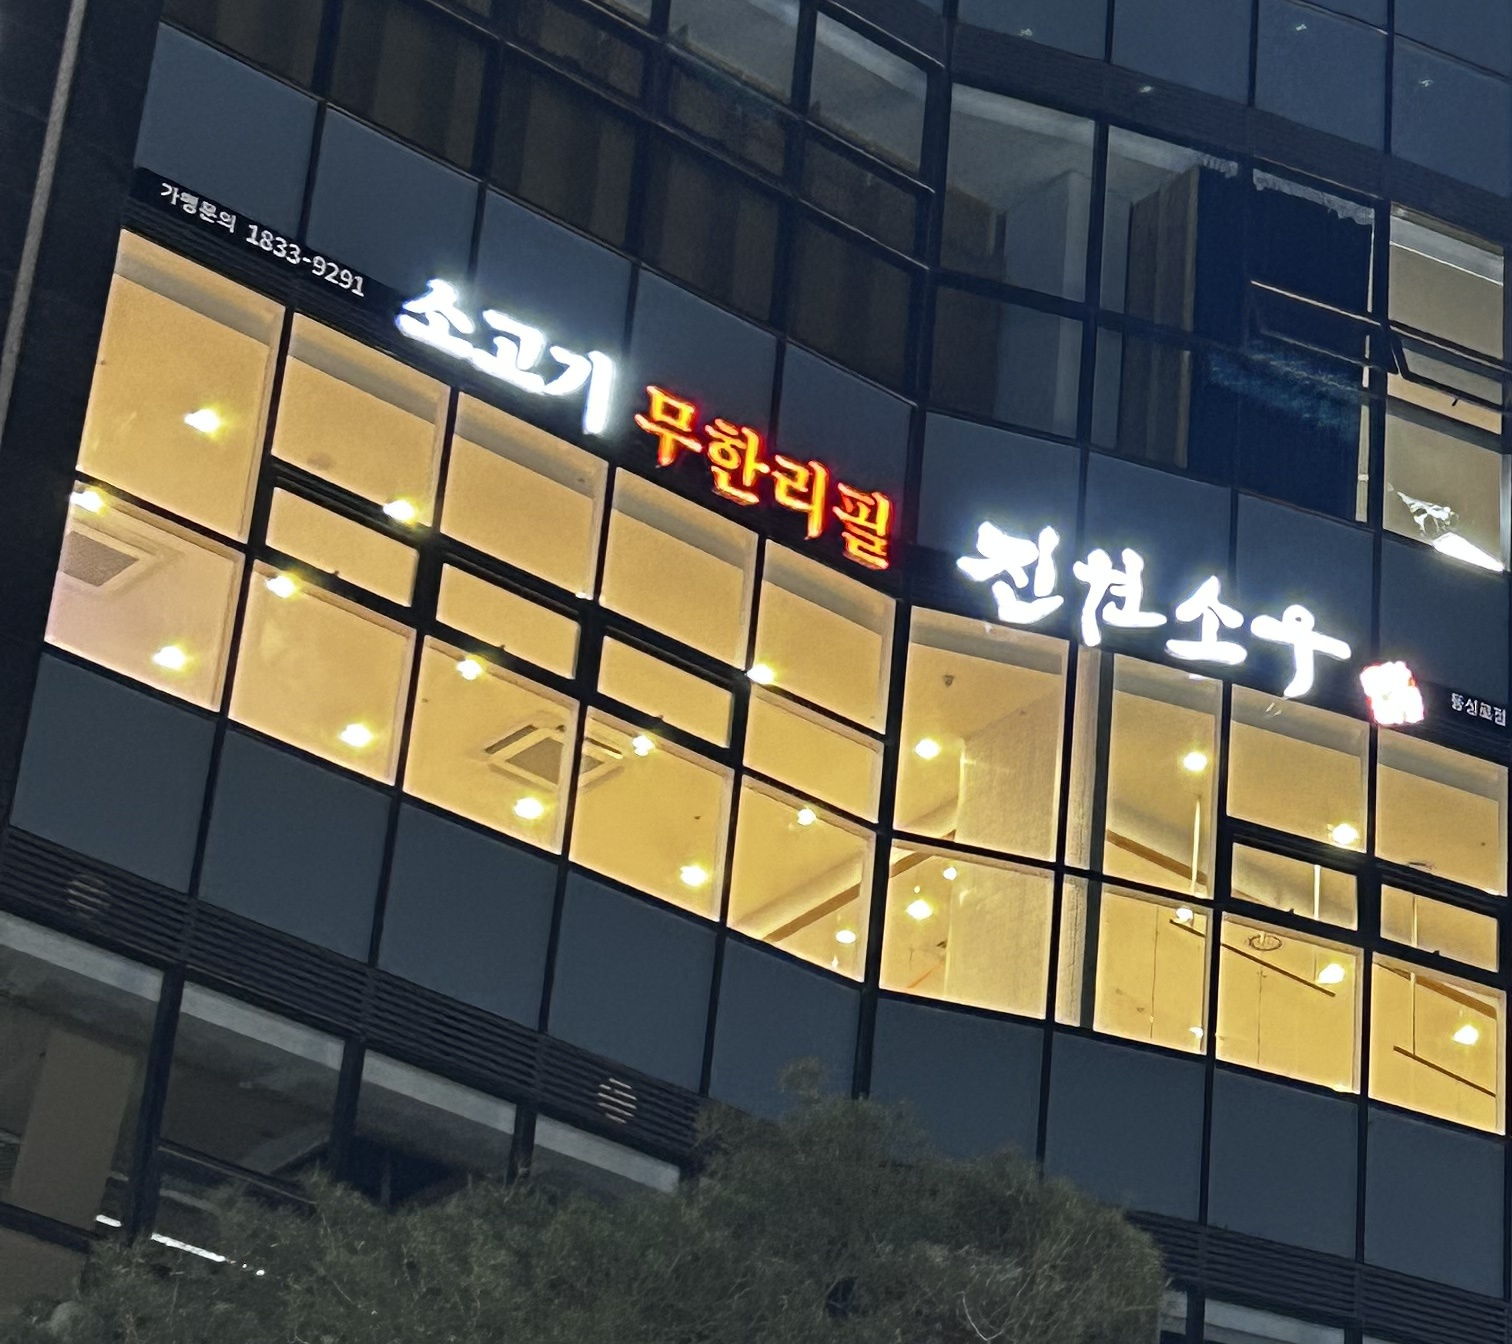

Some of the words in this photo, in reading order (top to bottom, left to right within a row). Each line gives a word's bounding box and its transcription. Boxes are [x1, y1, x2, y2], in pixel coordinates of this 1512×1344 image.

[246, 224, 365, 297] 1833-9291
[395, 277, 613, 435] 소고기
[634, 385, 894, 570] 무한리필
